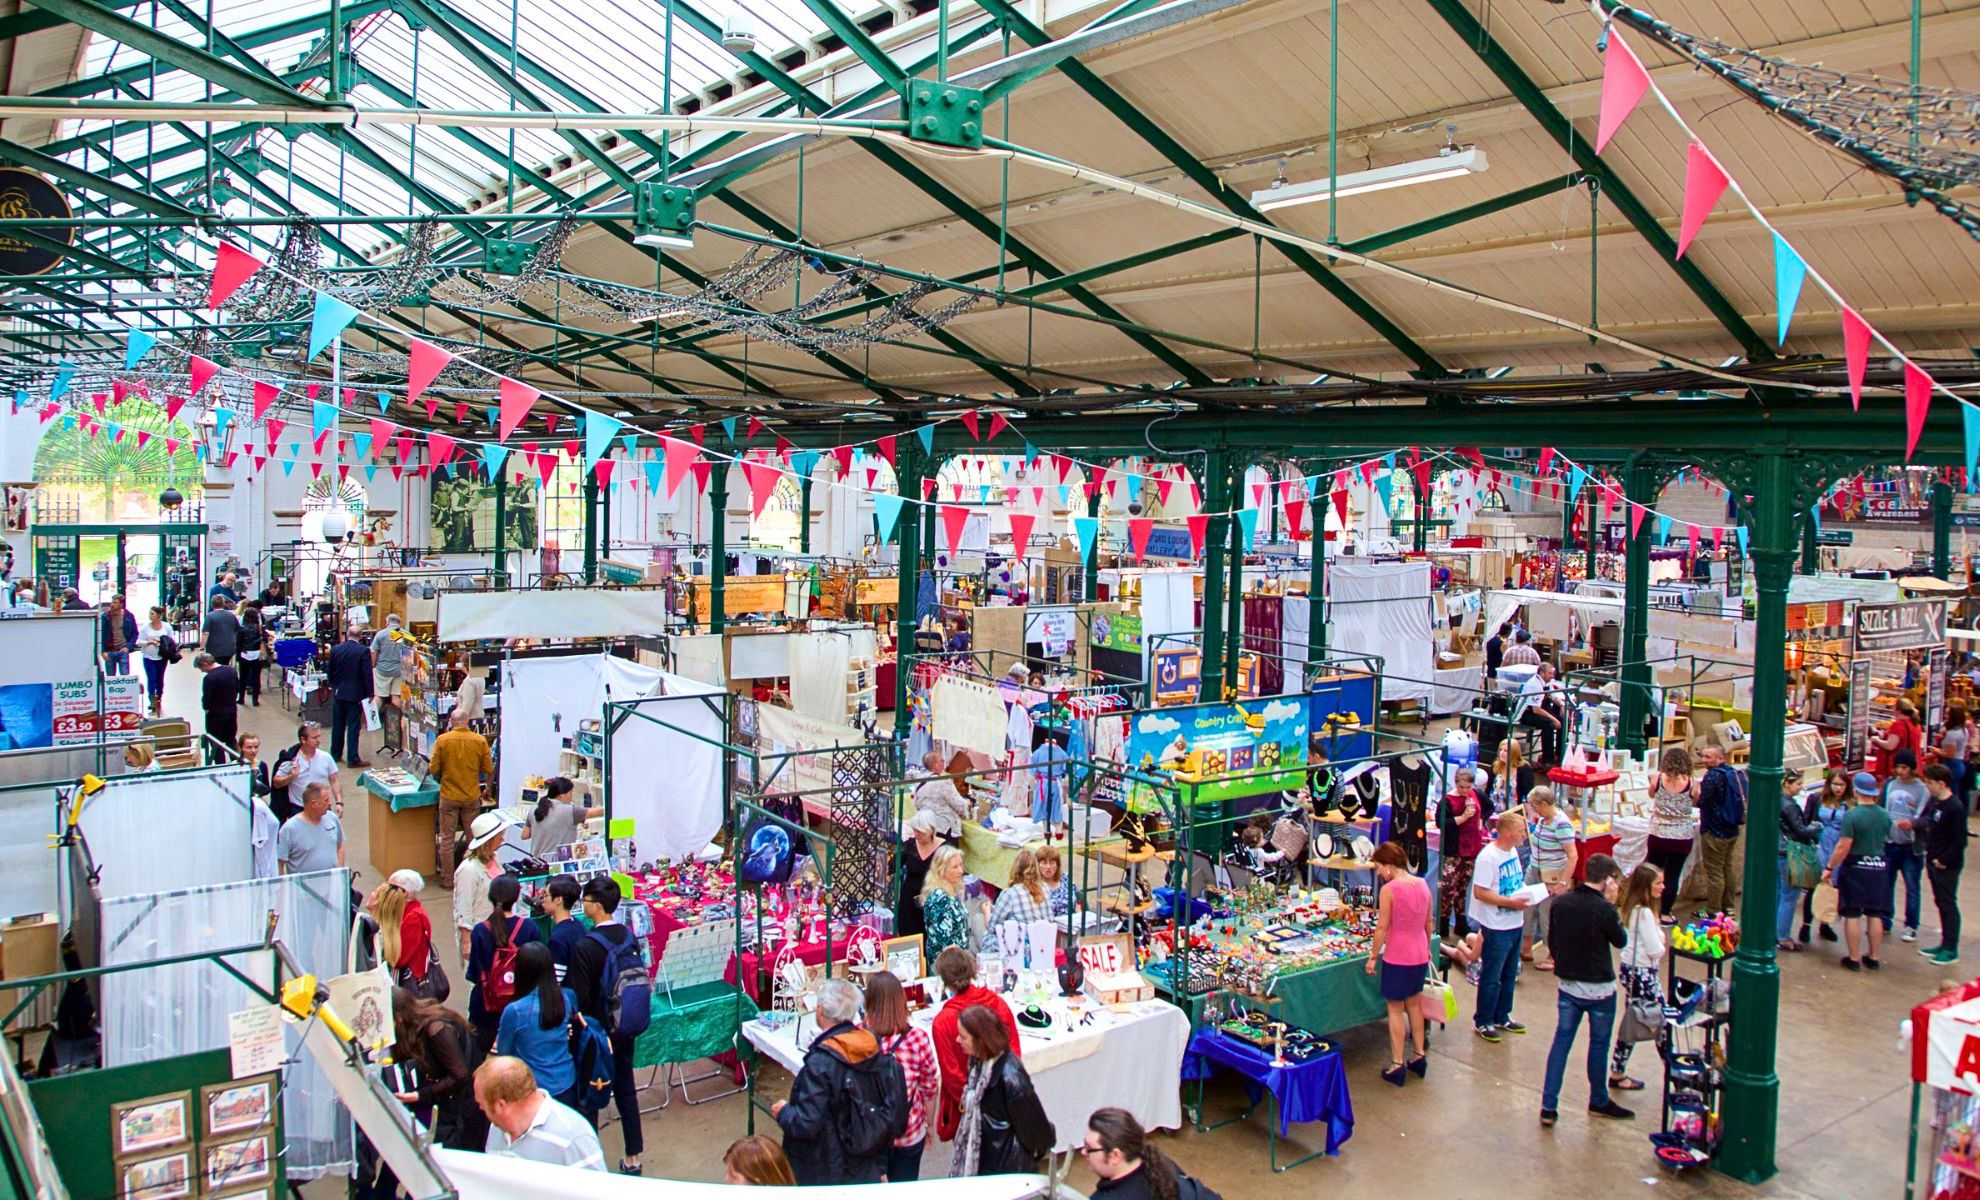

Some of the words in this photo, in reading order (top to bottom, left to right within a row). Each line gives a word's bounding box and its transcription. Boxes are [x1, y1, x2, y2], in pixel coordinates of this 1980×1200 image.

[1168, 536, 1189, 545] LOUGH
[1861, 610, 1889, 632] SIZZLE
[1892, 609, 1898, 629] &
[1901, 606, 1919, 628] ROLL
[55, 680, 93, 690] JUMBO
[104, 678, 138, 686] eakfast
[60, 689, 88, 699] SUBS
[108, 686, 127, 694] Bap
[57, 717, 93, 733] £3.50
[105, 714, 122, 729] £3
[1195, 716, 1225, 729] Country
[1081, 944, 1116, 974] SALE
